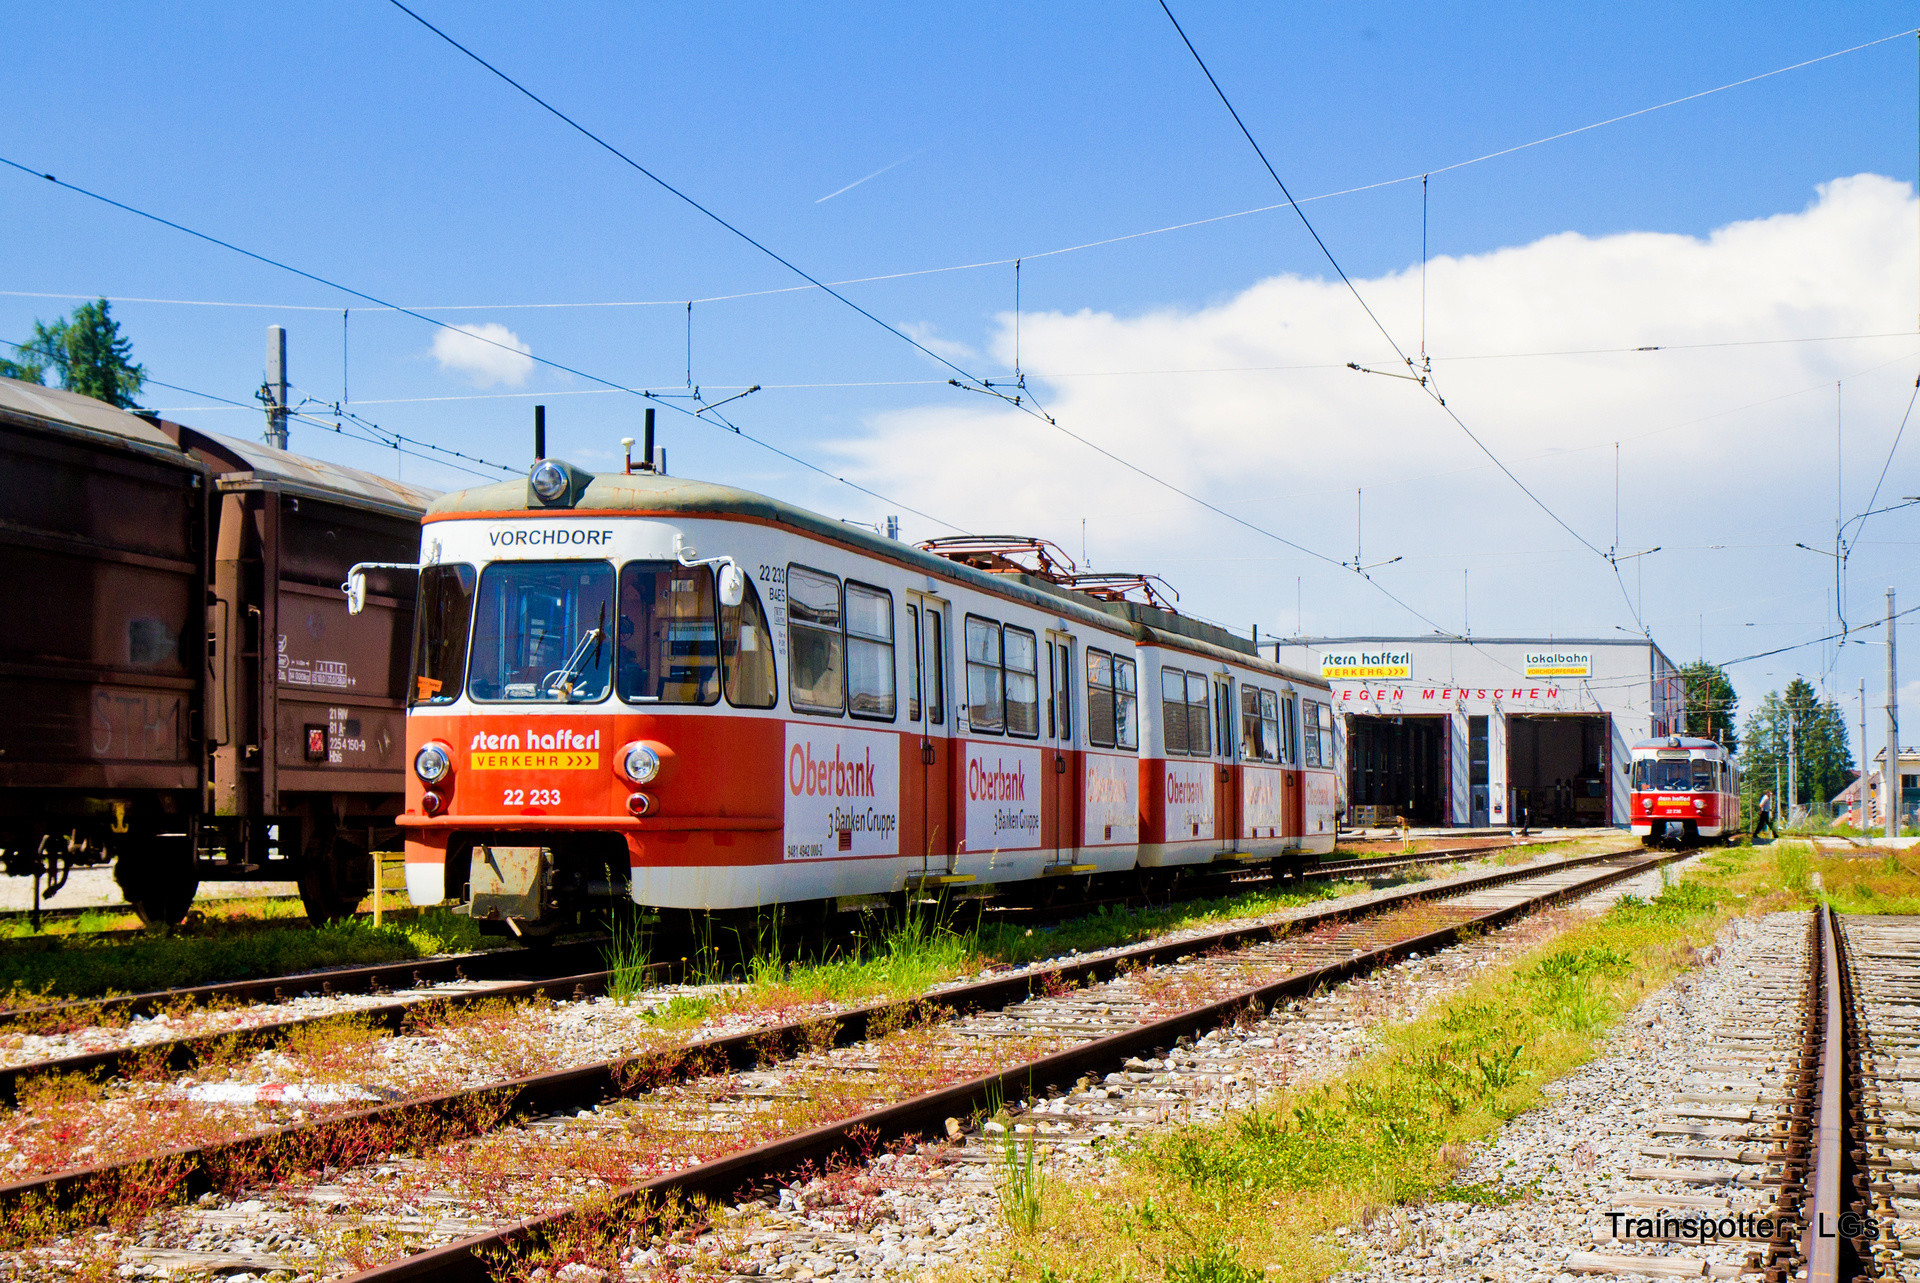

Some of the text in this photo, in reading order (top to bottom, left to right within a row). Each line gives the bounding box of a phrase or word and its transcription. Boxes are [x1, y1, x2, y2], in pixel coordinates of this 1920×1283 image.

[489, 530, 613, 546] VORCHDORF
[759, 564, 785, 584] 22 233
[1322, 652, 1409, 665] stern hafferl
[1326, 667, 1383, 676] VERKEHR
[1422, 688, 1558, 700] MENSCHEN
[329, 707, 337, 720] 21
[329, 722, 337, 734] 81
[329, 737, 341, 750] 225
[342, 738, 347, 750] 4
[470, 729, 600, 750] stern hafferl
[477, 755, 558, 766] VERKEHR
[789, 741, 875, 797] Oberbank
[968, 756, 1025, 801] Oberbank
[503, 789, 561, 805] 22 233
[827, 805, 896, 840] 3 Banken Gruppe
[994, 814, 998, 835] 3
[998, 807, 1018, 829] Banken
